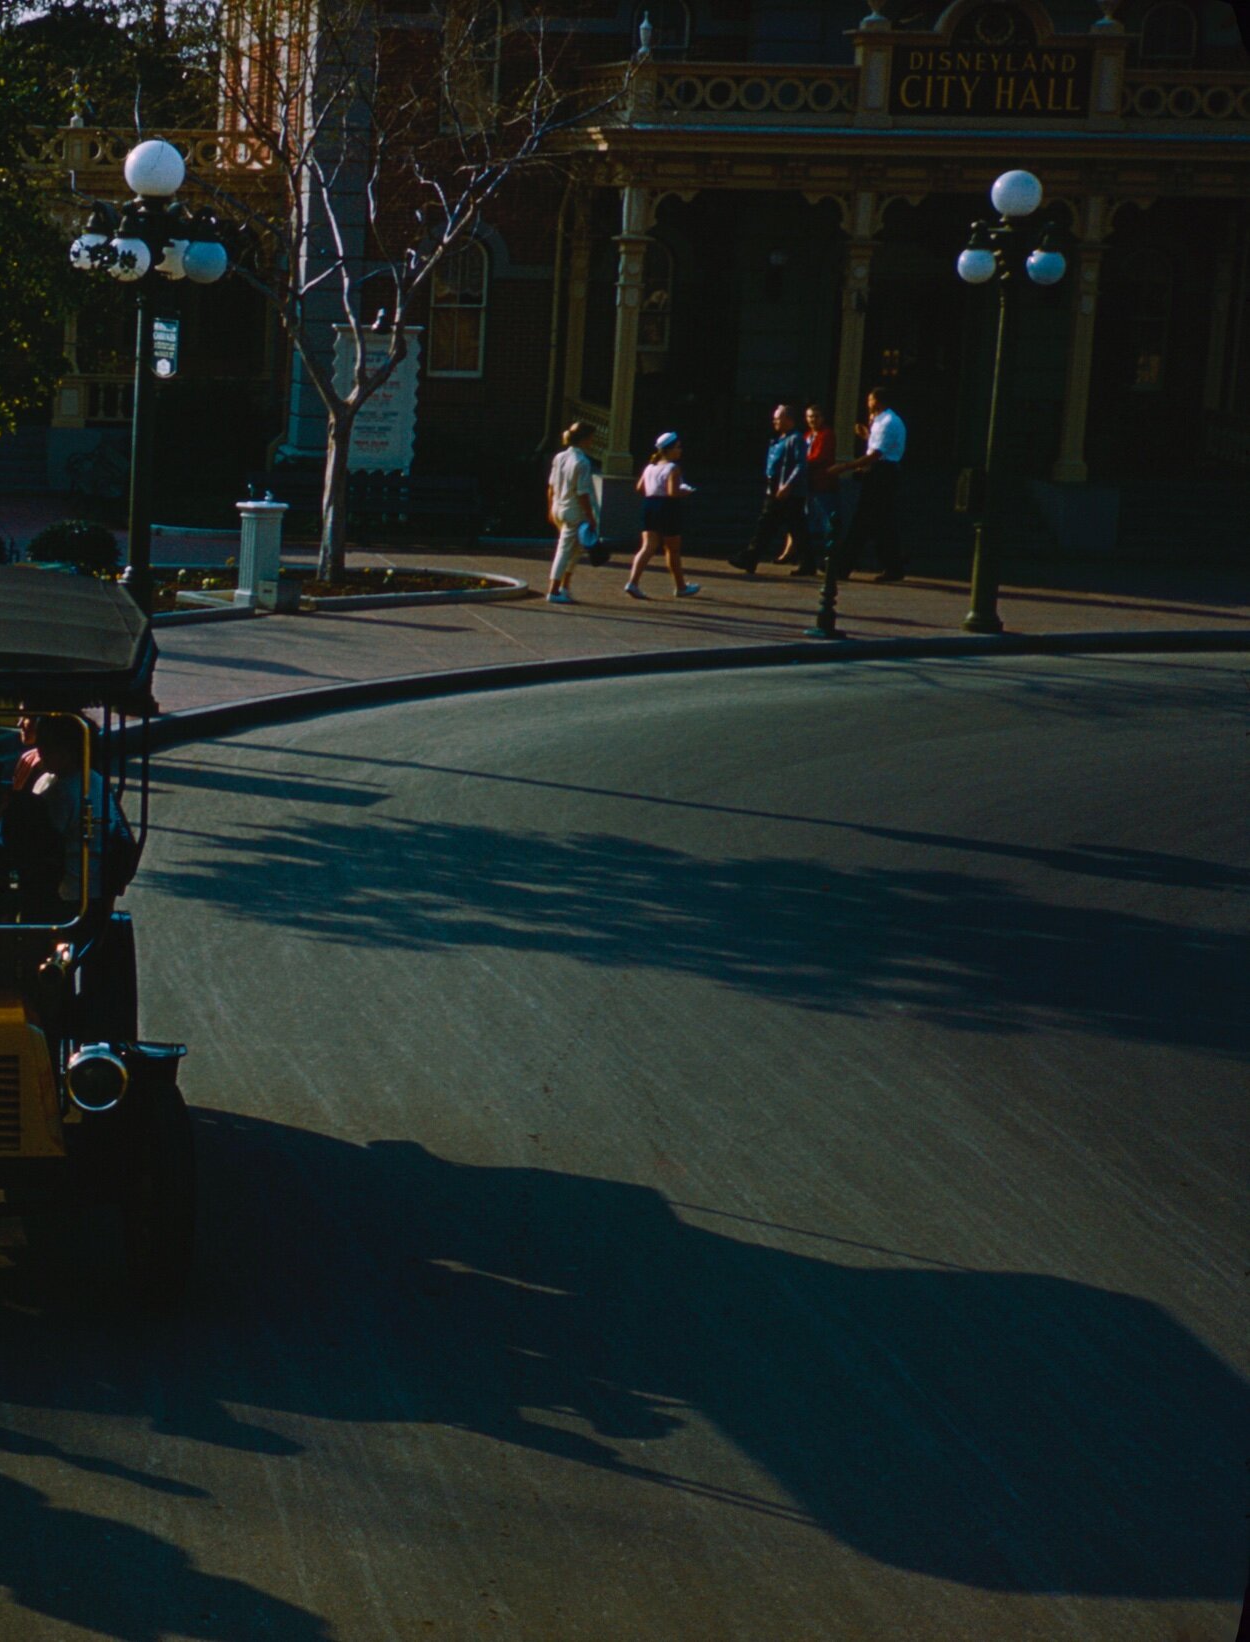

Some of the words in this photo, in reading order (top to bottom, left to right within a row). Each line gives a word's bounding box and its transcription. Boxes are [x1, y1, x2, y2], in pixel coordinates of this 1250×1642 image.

[909, 50, 1077, 73] DISNEYLAND
[898, 74, 981, 109] CITY
[994, 75, 1081, 111] HALL
